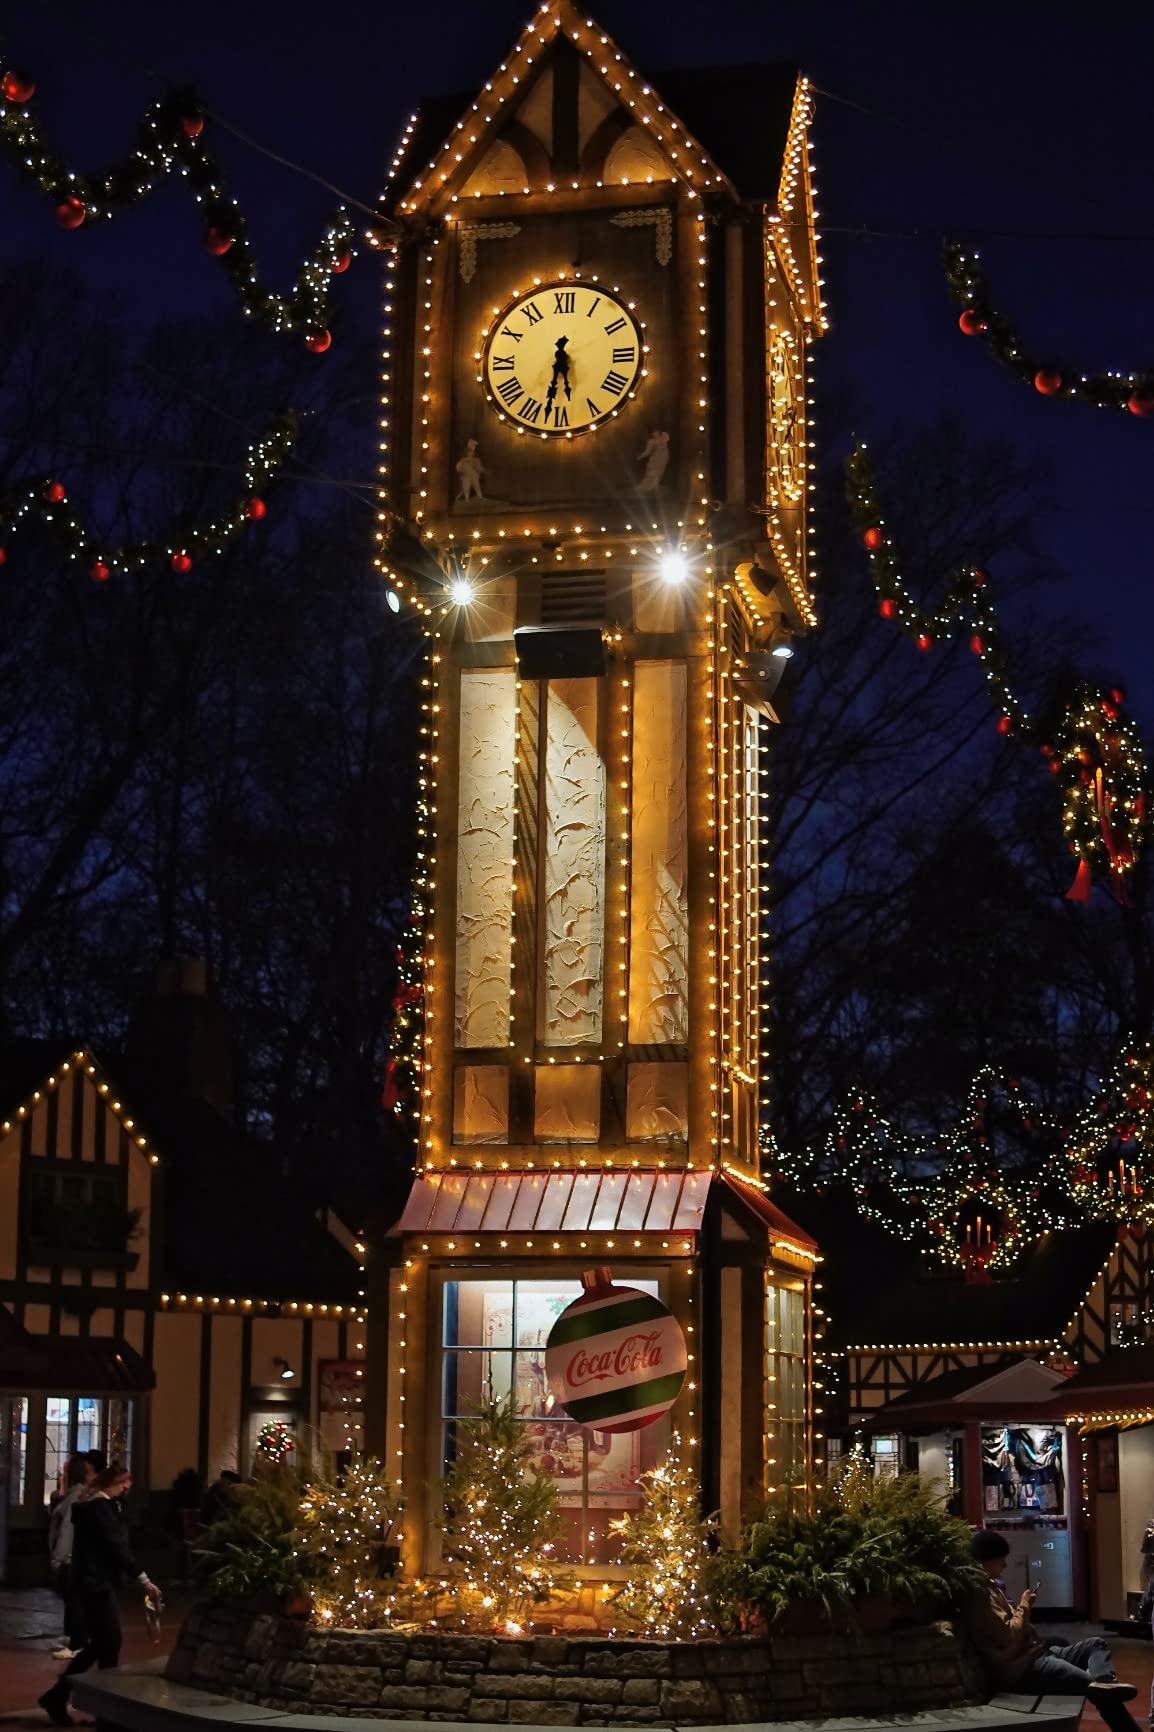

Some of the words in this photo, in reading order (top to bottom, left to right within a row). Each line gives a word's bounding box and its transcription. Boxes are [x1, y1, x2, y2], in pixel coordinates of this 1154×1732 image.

[520, 301, 544, 327] XI
[553, 292, 576, 314] XII
[586, 297, 602, 318] I
[500, 326, 524, 343] X
[604, 317, 628, 336] II
[493, 355, 515, 371] IX
[612, 347, 635, 364] III
[496, 376, 525, 408] VIII
[600, 370, 630, 397] IIII
[517, 397, 543, 424] VII
[553, 406, 570, 428] VI
[586, 398, 602, 418] V
[566, 1330, 664, 1388] Coca-Cola
